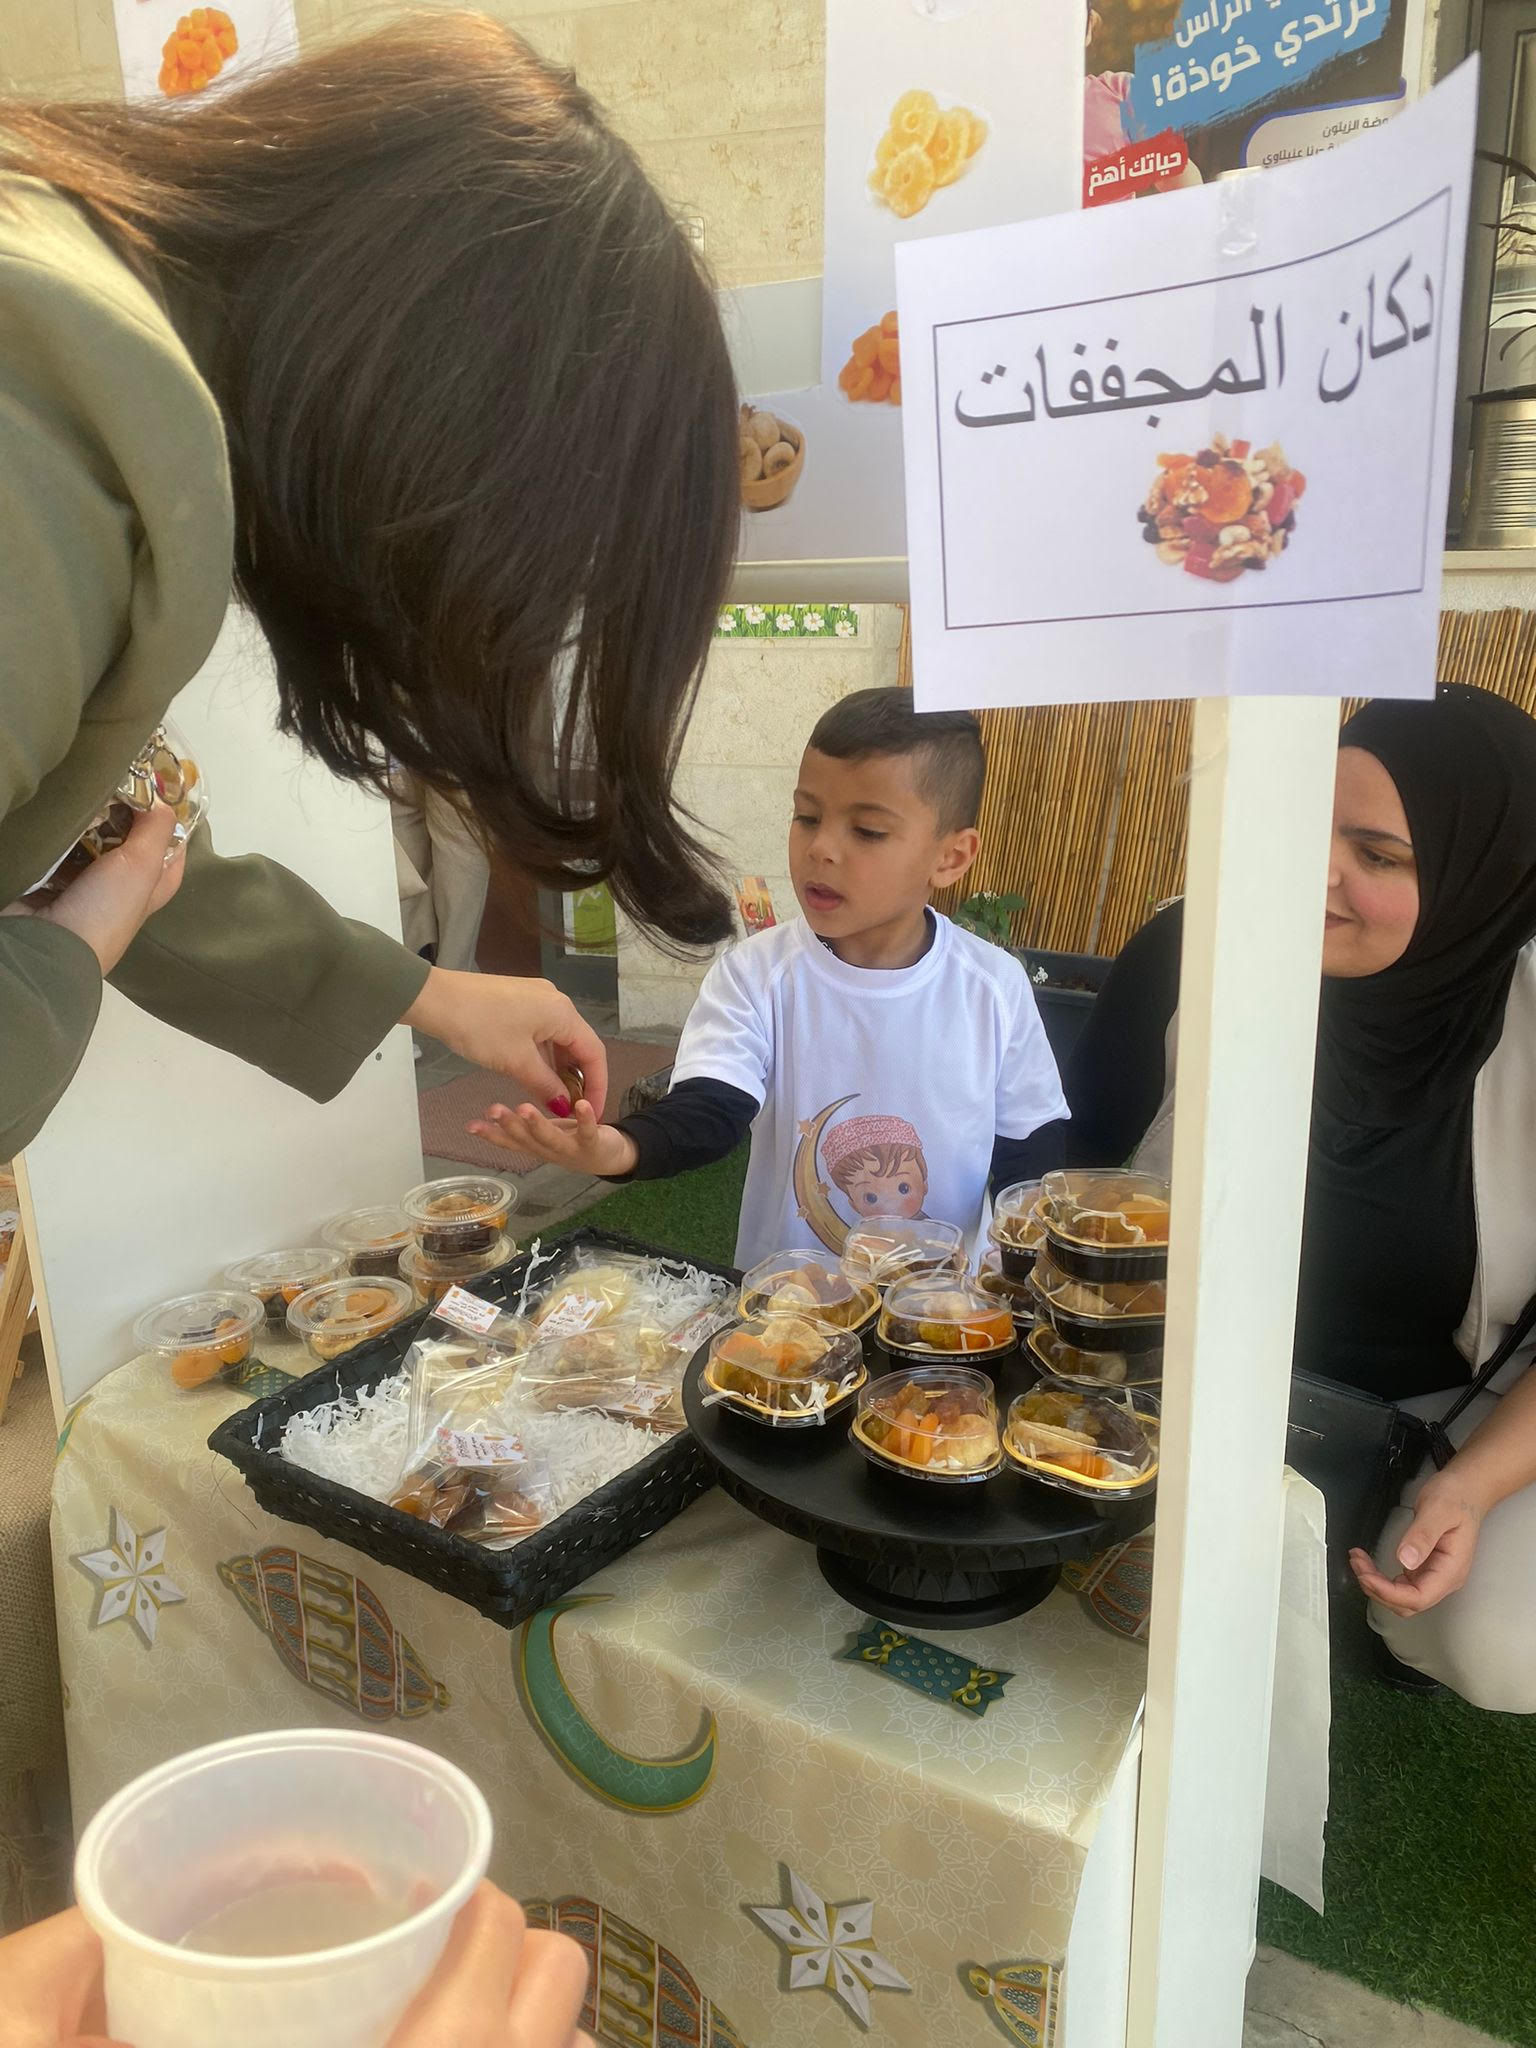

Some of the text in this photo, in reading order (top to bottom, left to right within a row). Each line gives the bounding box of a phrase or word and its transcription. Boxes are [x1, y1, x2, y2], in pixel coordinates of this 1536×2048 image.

[1152, 36, 1261, 107] خوذة!
[1128, 152, 1182, 176] حياتك
[954, 253, 1435, 429] دكان المجففات
